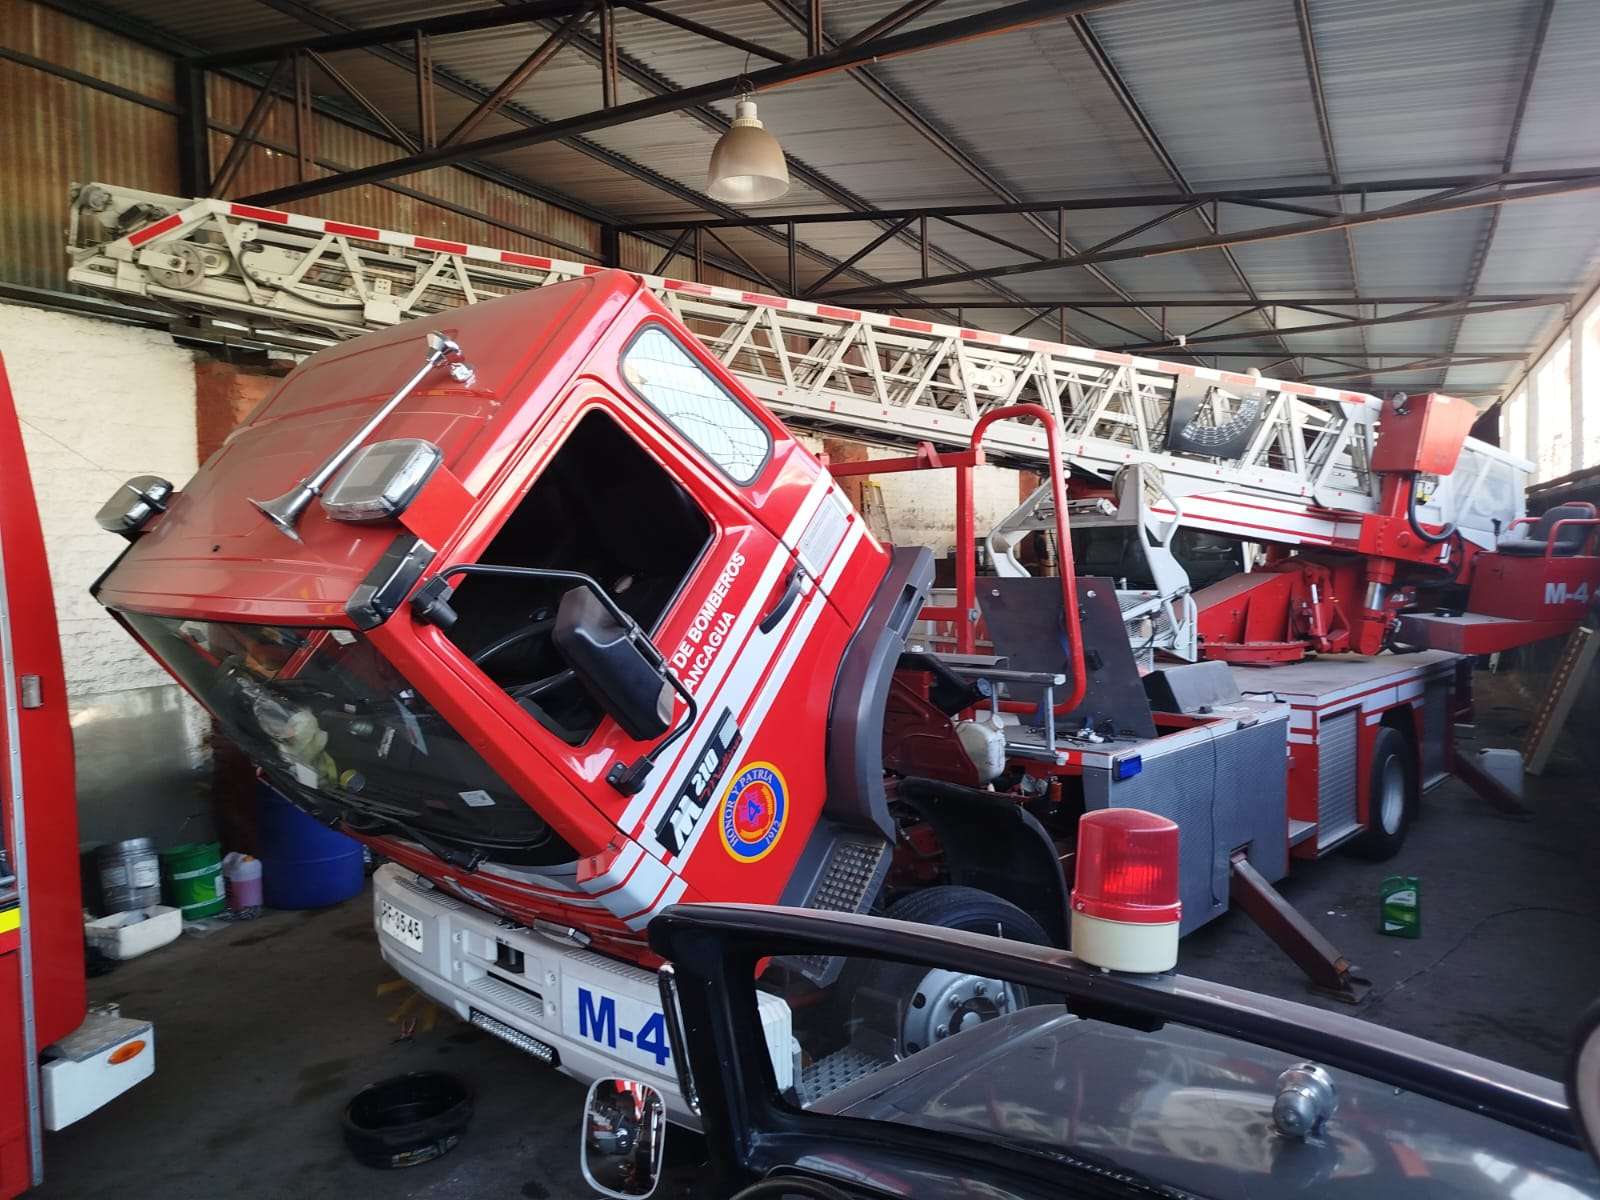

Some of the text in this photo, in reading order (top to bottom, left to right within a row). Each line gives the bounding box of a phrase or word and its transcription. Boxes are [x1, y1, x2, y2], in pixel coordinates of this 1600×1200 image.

[672, 552, 746, 669] DE BOMBEROS
[1544, 582, 1589, 605] M-4
[724, 800, 739, 847] HONOR
[737, 769, 773, 788] PATRIA
[577, 986, 671, 1067] M-4
